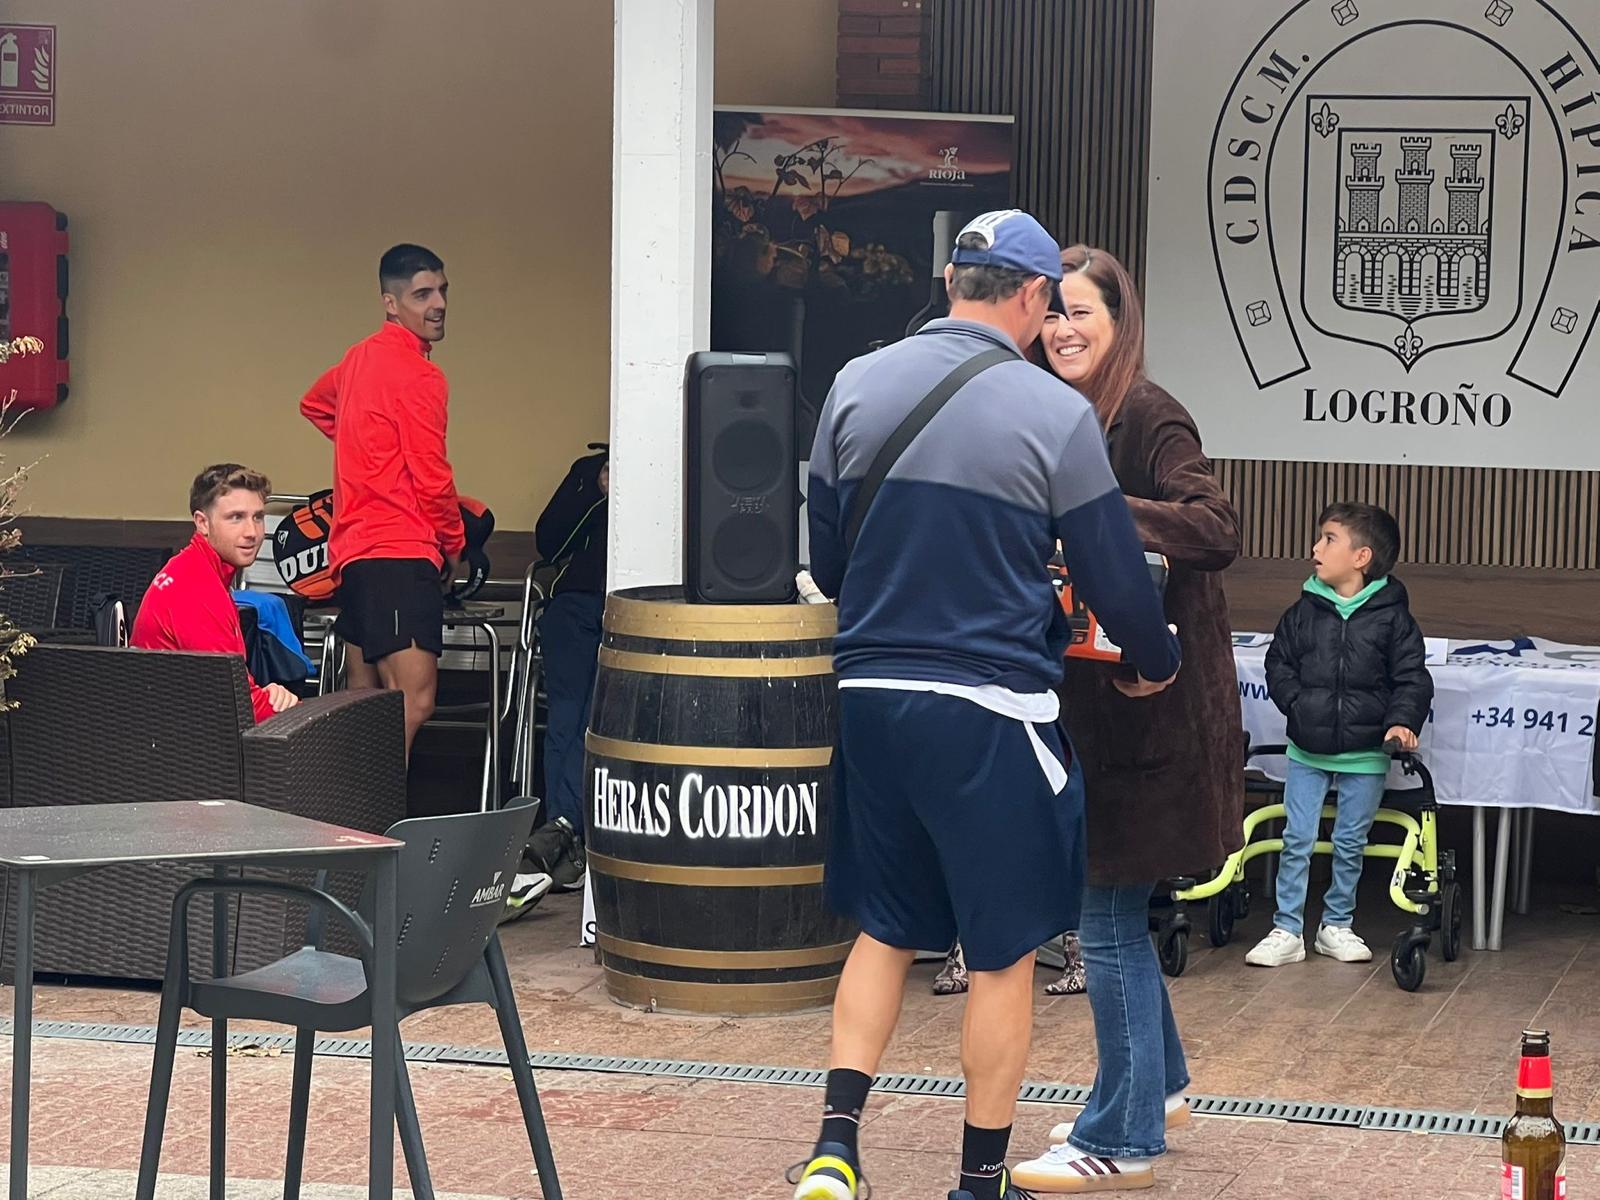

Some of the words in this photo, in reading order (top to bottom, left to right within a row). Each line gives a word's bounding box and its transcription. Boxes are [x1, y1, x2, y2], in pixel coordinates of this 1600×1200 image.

[1303, 383, 1512, 428] LOGROÑO
[1471, 706, 1516, 729] +34
[1523, 708, 1568, 733] 941
[1577, 714, 1594, 737] 2
[593, 767, 672, 838] HERAS
[678, 772, 819, 840] CORDON
